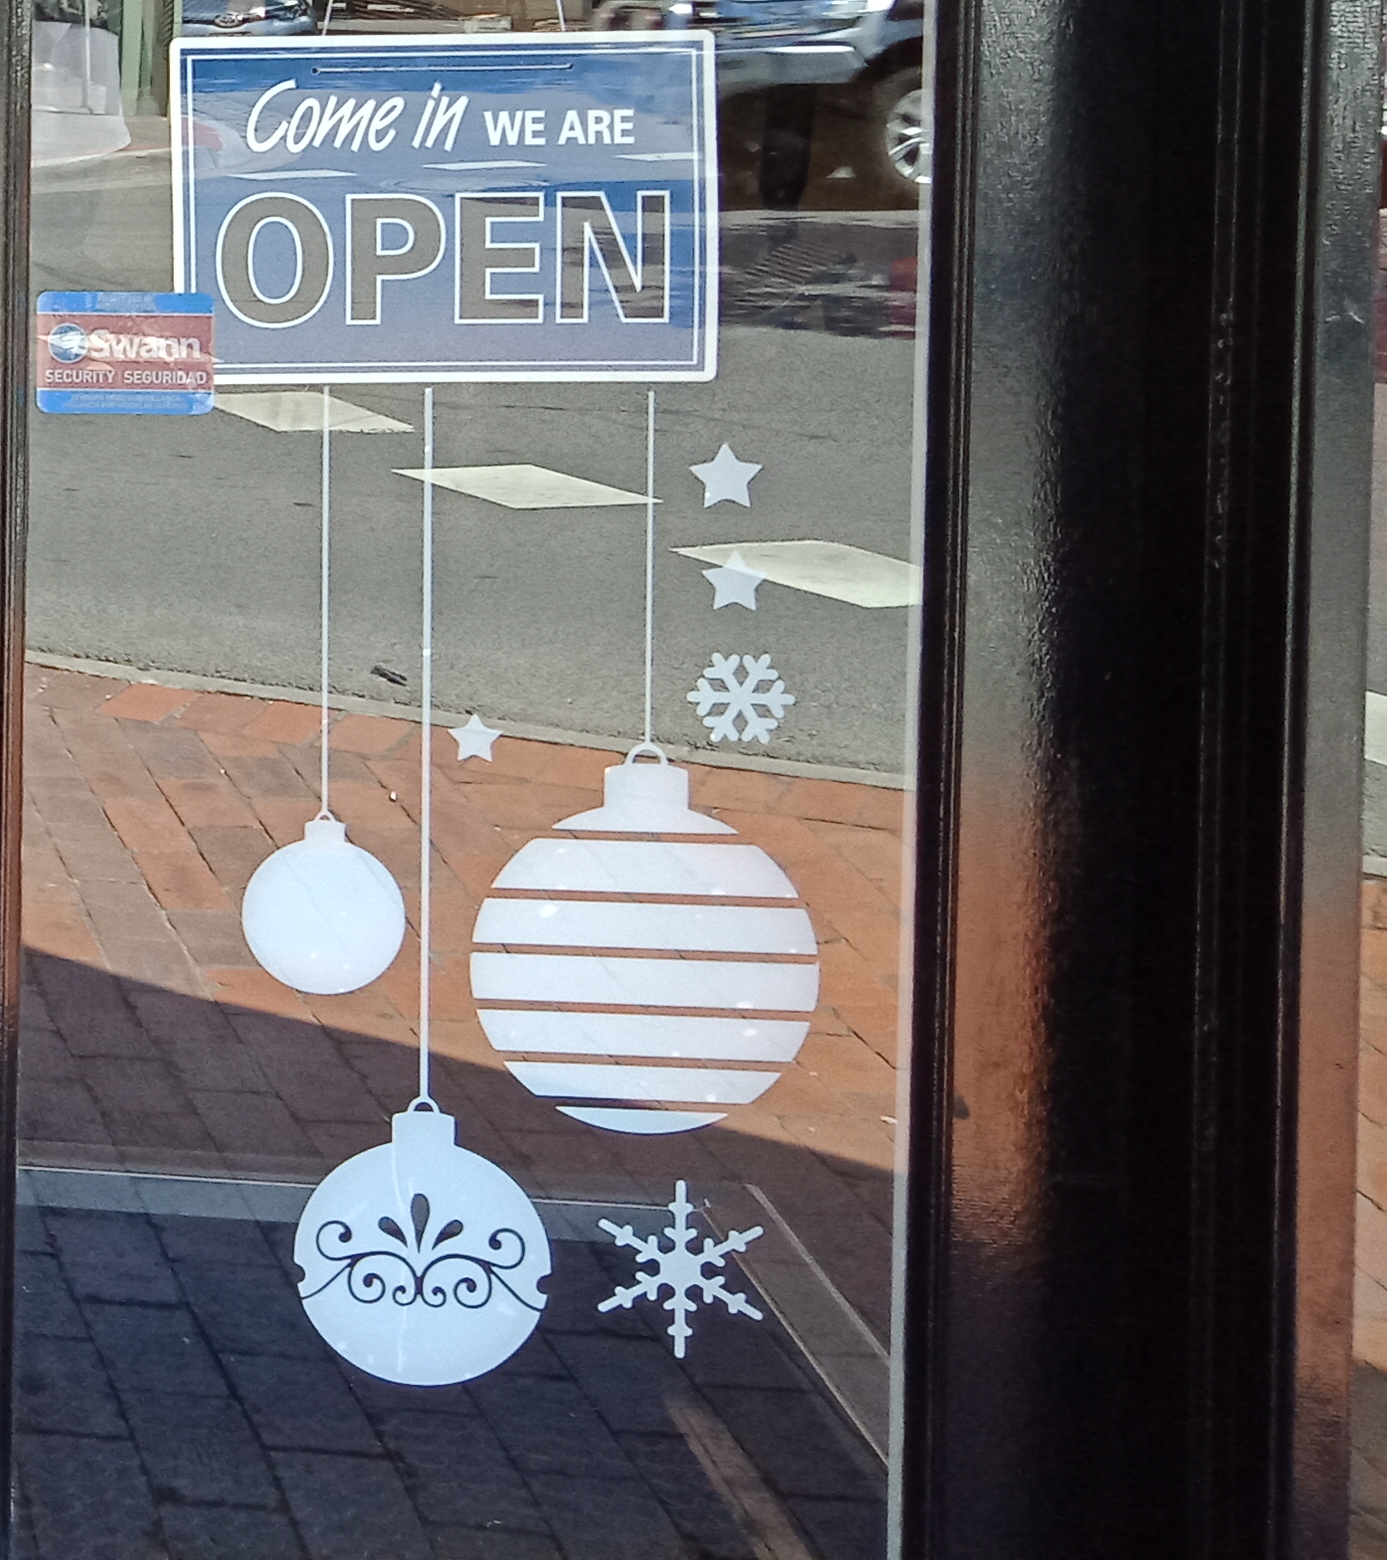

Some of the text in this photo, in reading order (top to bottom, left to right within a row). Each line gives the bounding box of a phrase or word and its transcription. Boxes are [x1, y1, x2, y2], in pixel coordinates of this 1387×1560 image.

[245, 78, 635, 154] Come in WE ARE
[215, 189, 671, 328] OPEN
[88, 329, 202, 361] Swann
[44, 369, 208, 385] SECURITY SEGURIDAD
